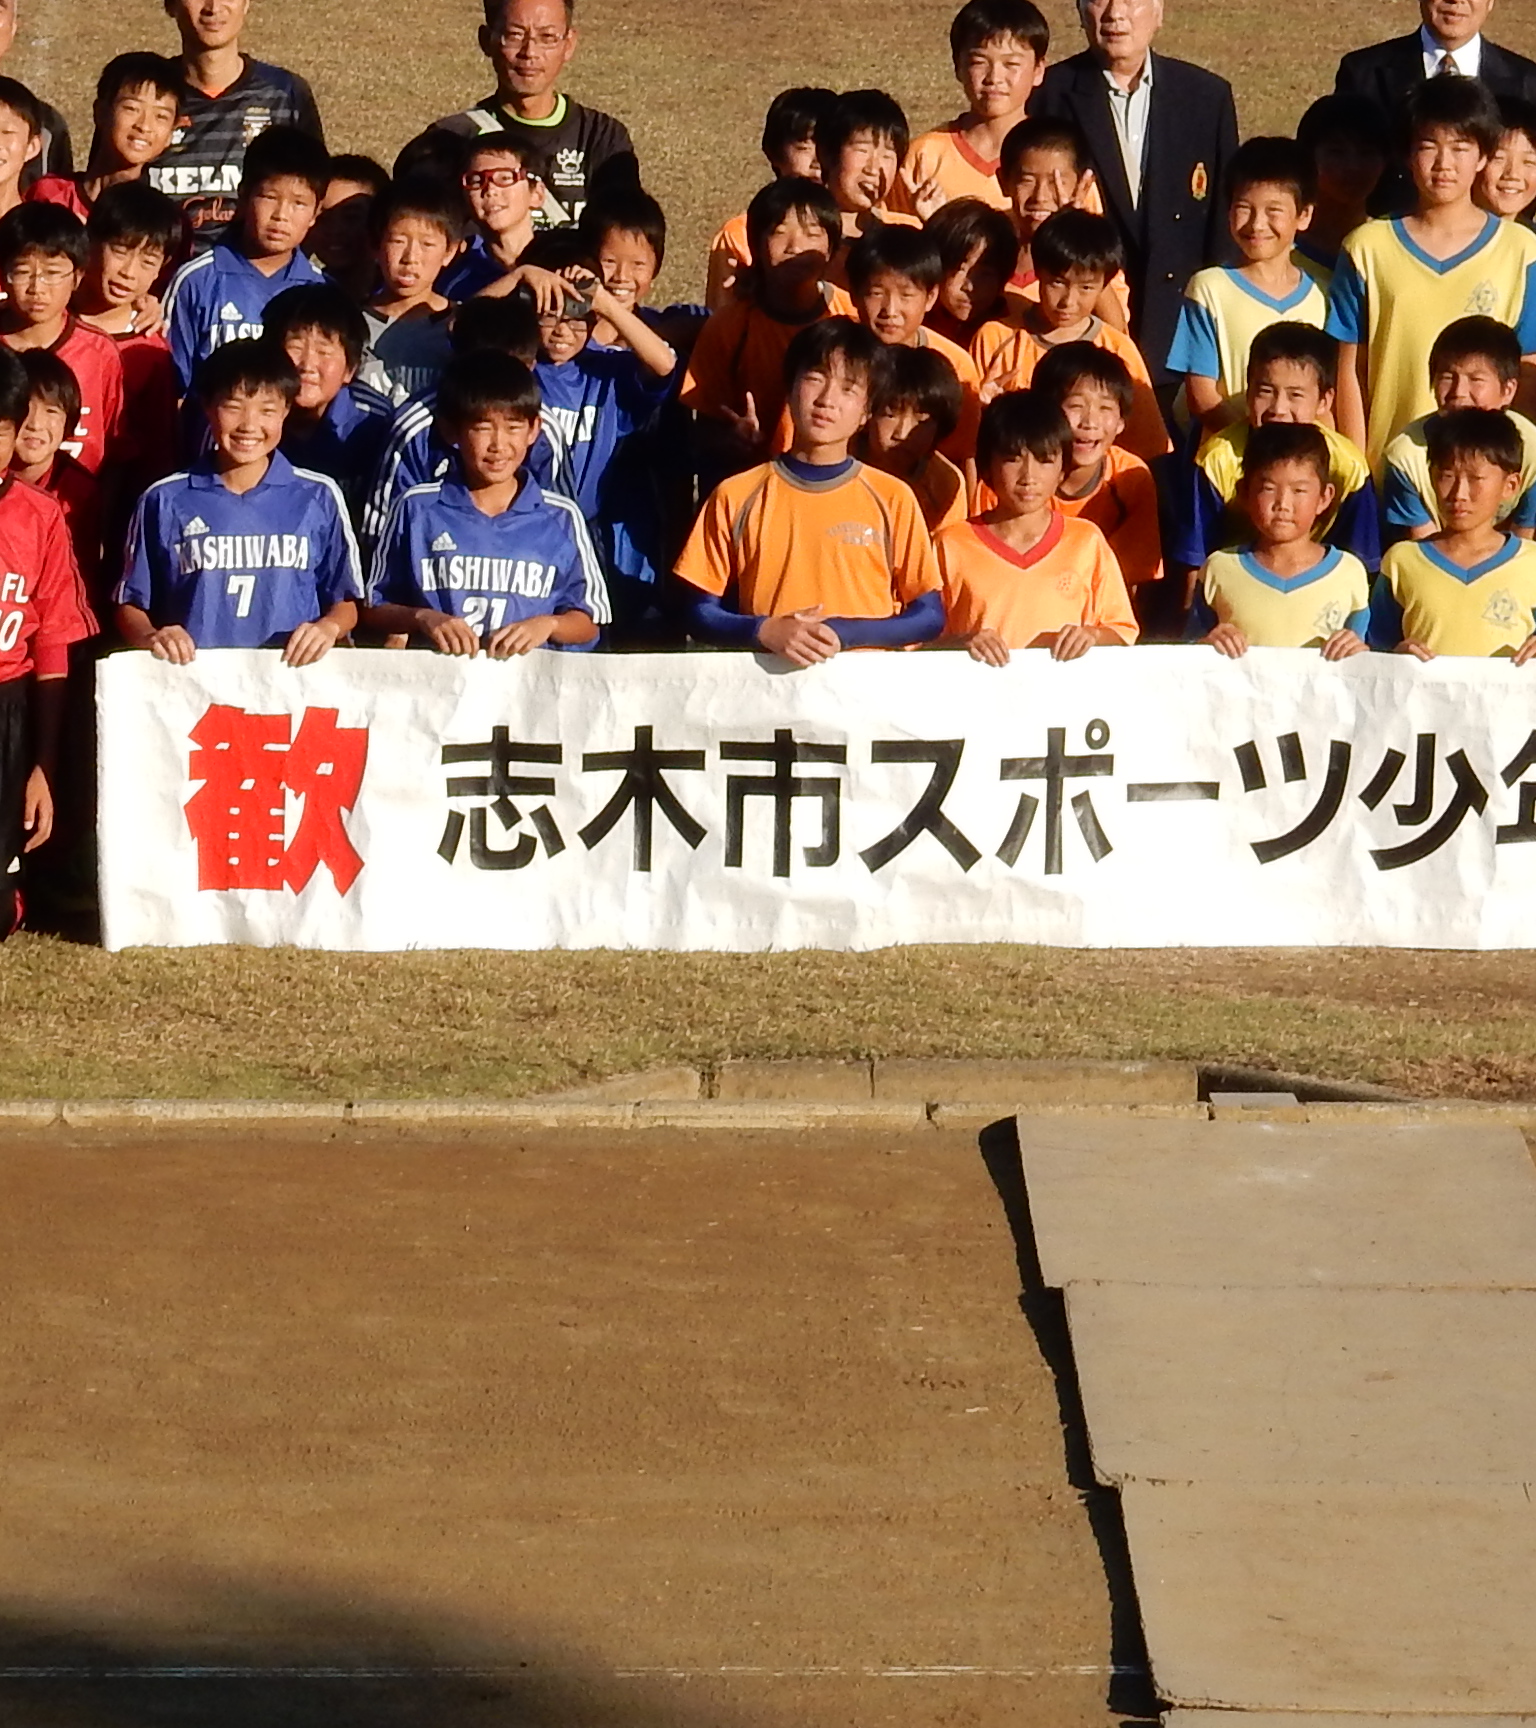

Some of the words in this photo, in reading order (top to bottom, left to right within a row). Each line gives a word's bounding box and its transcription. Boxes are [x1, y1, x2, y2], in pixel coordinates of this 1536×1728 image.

[174, 534, 309, 576] KASHIWABA
[421, 555, 557, 598] KASHIWABA
[227, 575, 256, 618] 7
[462, 596, 508, 638] 21
[184, 703, 370, 898] 歓
